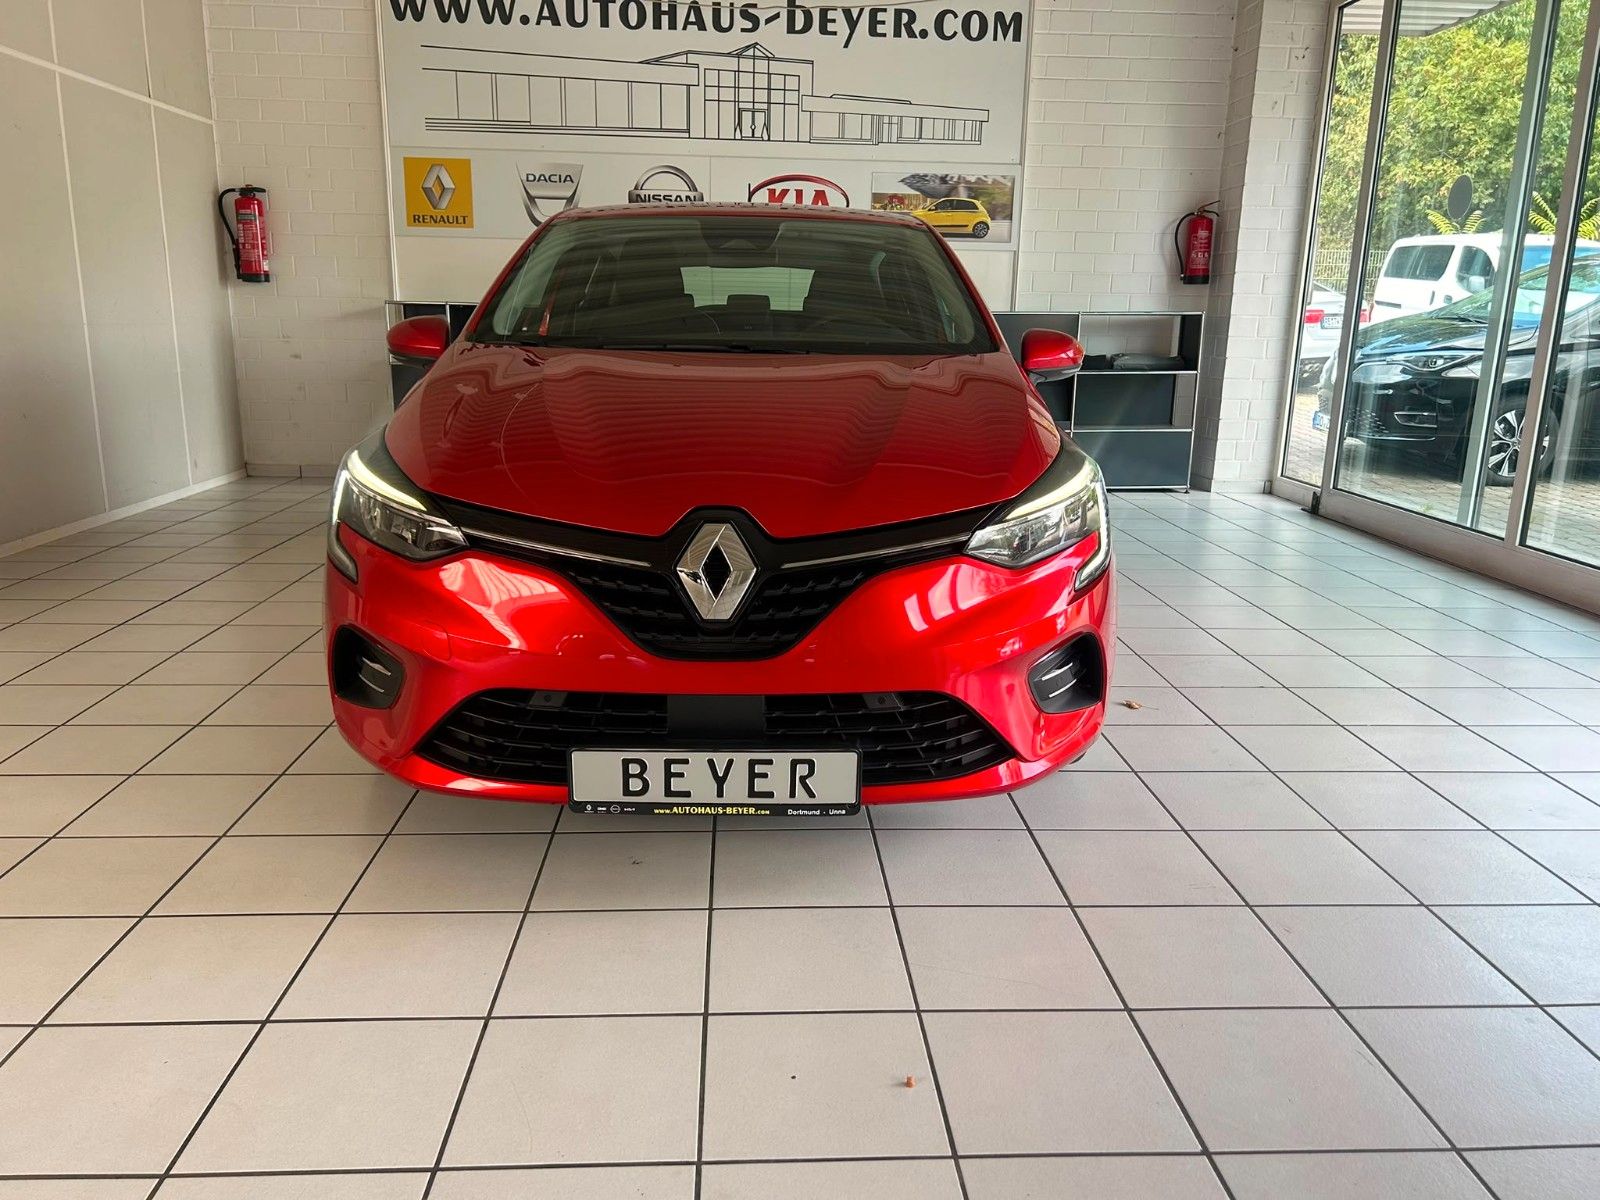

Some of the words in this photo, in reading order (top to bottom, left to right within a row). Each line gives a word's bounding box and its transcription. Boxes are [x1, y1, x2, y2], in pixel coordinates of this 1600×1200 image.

[525, 173, 575, 184] DACIA
[767, 188, 829, 206] KIA
[412, 214, 468, 225] RENAULT
[620, 757, 817, 799] BEYER
